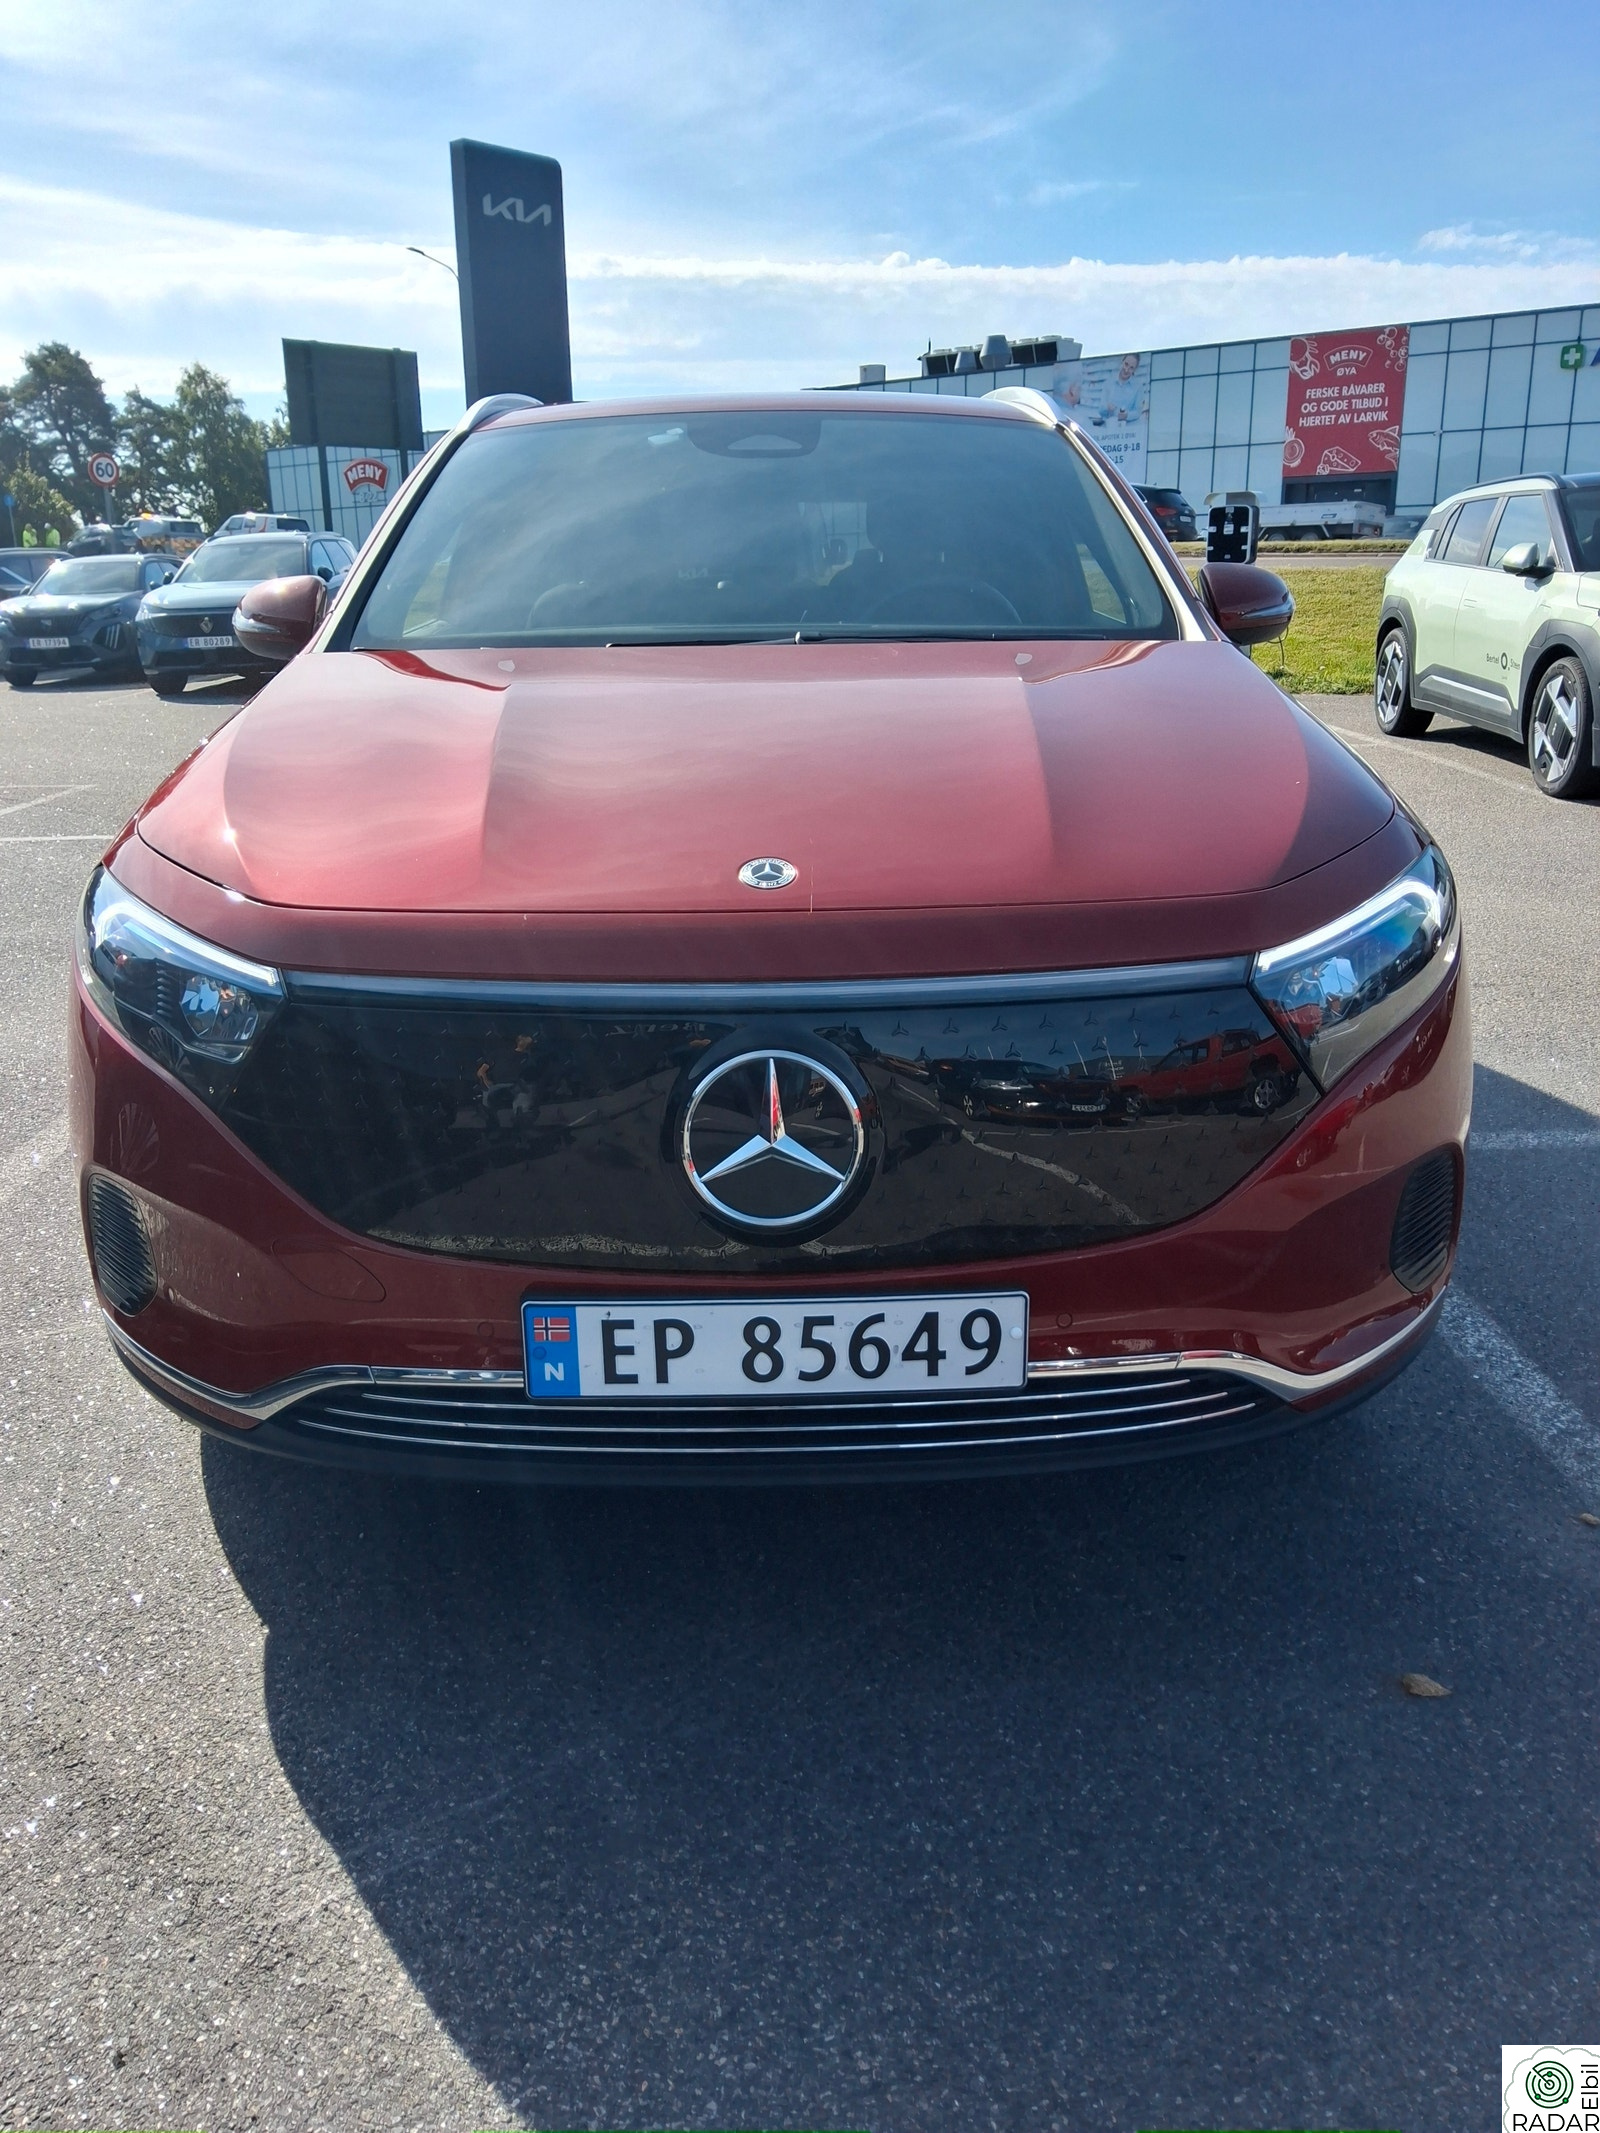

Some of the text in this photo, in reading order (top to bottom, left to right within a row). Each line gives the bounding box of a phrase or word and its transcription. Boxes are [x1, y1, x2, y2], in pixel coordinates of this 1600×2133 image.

[1329, 350, 1367, 364] MENY
[1336, 367, 1357, 376] ØYA
[1306, 383, 1385, 399] FERSKE RÅVARER
[1301, 397, 1389, 413] OG GODE TILBUD I
[1299, 411, 1388, 427] HJERTET AV LARVIK
[1124, 442, 1141, 452] 9-18
[96, 462, 115, 478] 60
[347, 464, 383, 484] MENY
[190, 637, 231, 647] ER 80289
[601, 1308, 1002, 1385] EP 85649
[544, 1362, 565, 1381] N
